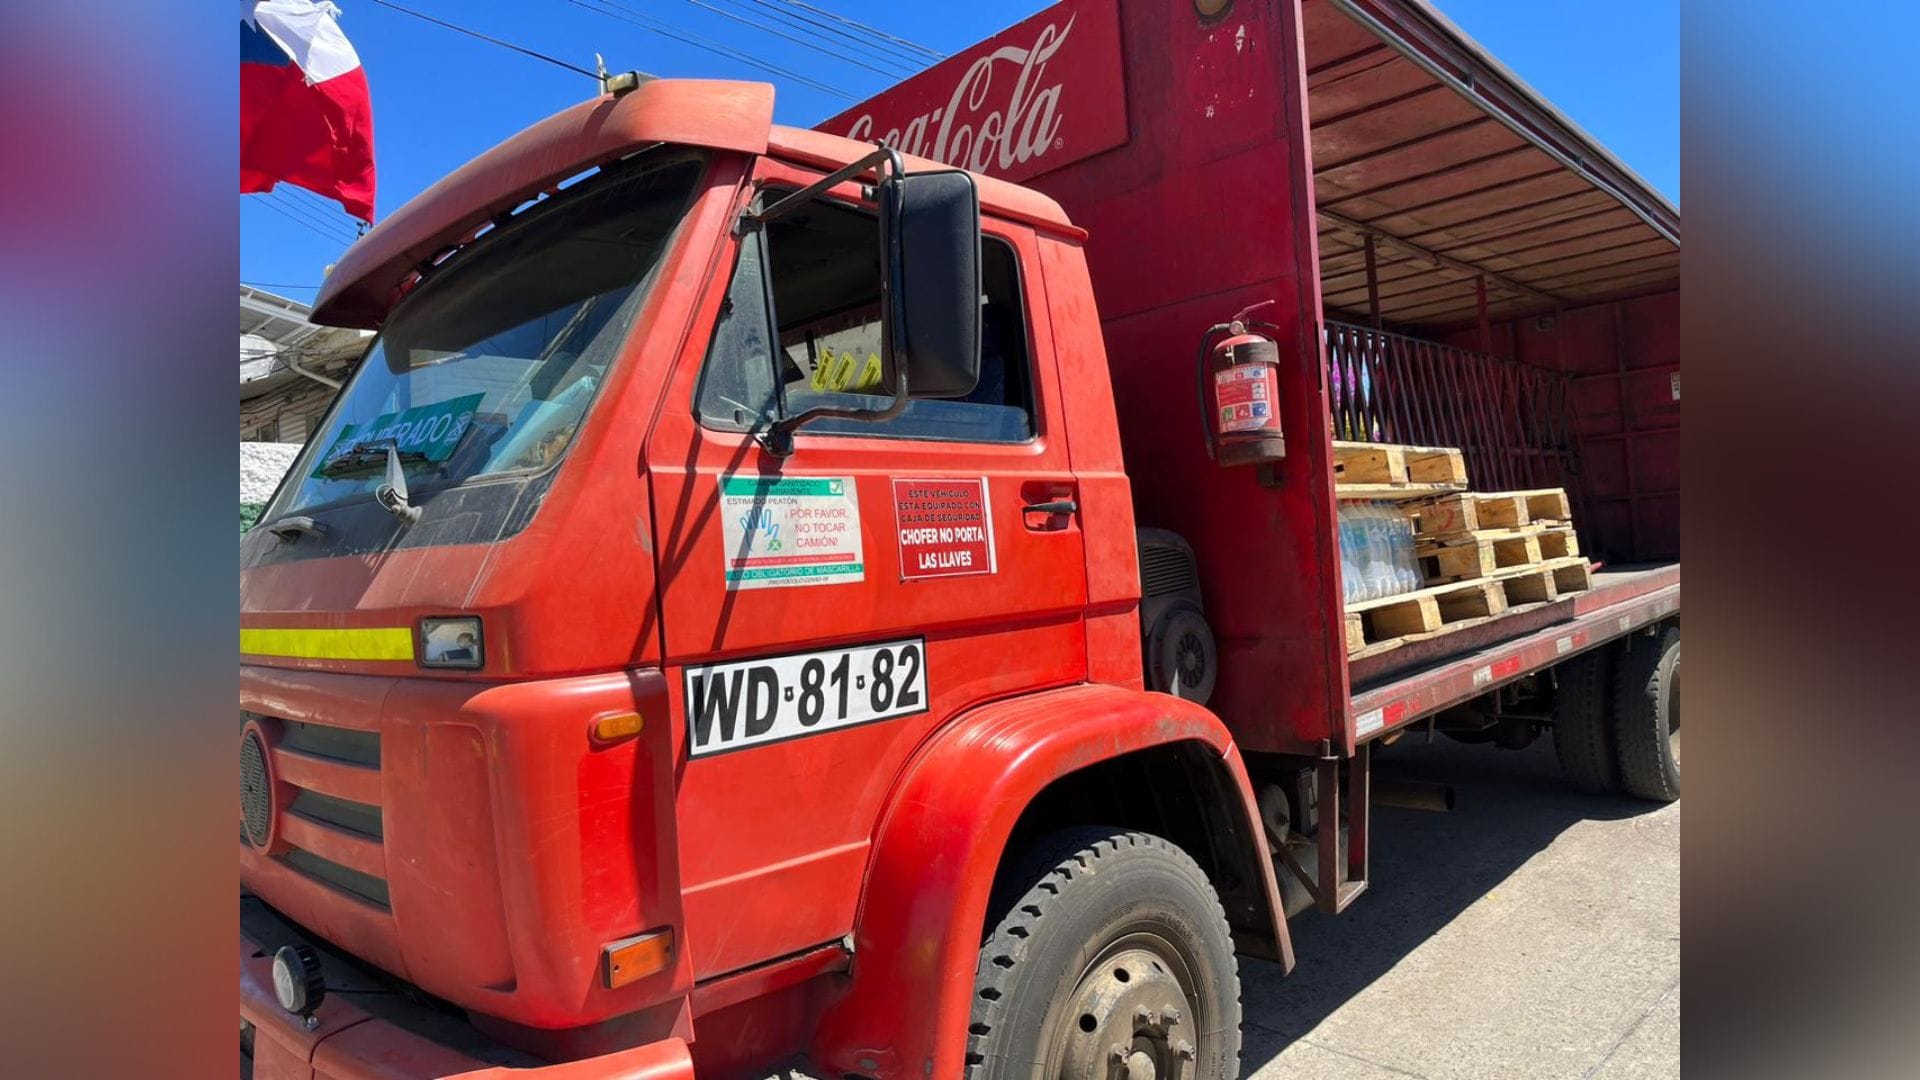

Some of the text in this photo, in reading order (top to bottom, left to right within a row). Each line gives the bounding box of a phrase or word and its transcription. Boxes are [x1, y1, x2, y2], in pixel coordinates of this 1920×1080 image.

[848, 10, 1077, 174] a-Cola
[908, 490, 928, 498] ESTE
[727, 496, 798, 505] ESTIMADO PEATÓN
[922, 502, 962, 511] EQUIPADO
[901, 514, 923, 522] CAJA
[937, 513, 981, 522] SEGURIDAD
[795, 522, 846, 533] NO TOCAR
[900, 526, 985, 545] CHOFER NO PORTA
[918, 550, 972, 569] LAS LLAVES
[751, 567, 804, 578] OBLIGATORIO
[806, 566, 814, 575] DE
[816, 564, 861, 575] MASCARILLA
